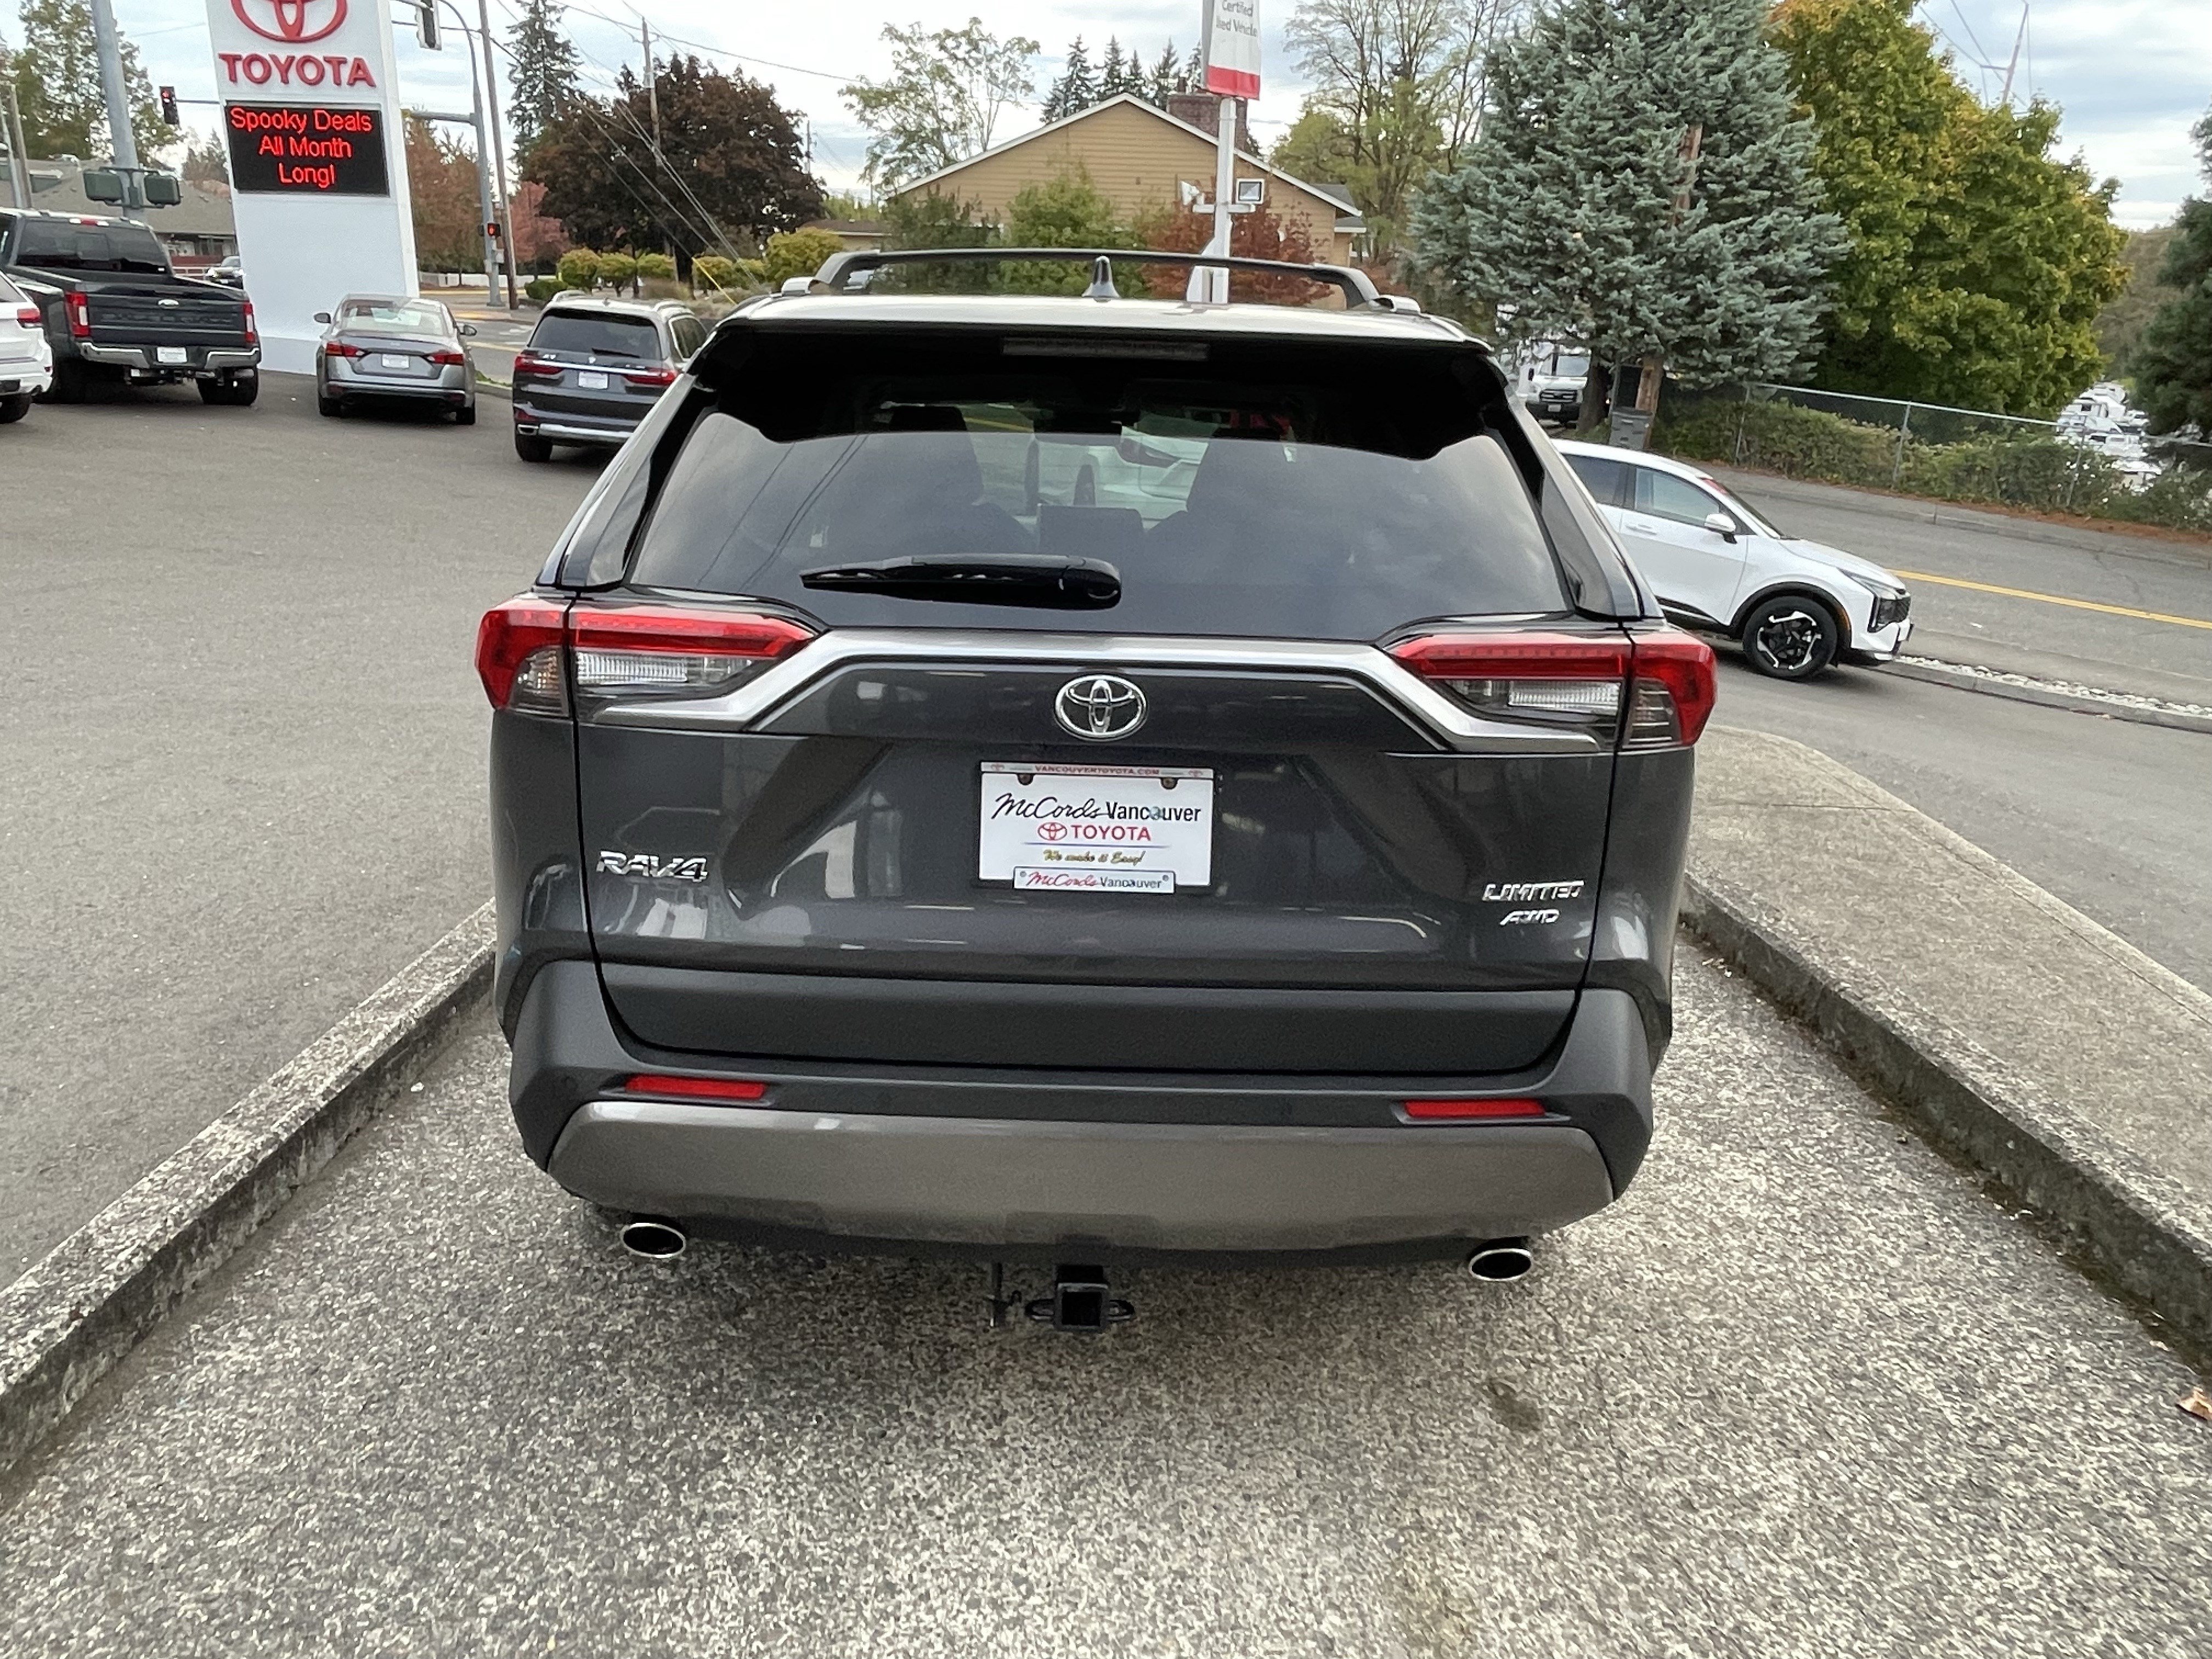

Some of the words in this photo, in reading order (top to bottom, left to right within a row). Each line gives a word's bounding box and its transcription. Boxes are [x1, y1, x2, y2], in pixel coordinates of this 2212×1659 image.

[218, 53, 376, 88] TOYOTA
[230, 107, 307, 134] Spooky
[313, 109, 373, 132] Deals
[258, 135, 284, 156] All
[289, 136, 353, 159] Month
[1035, 765, 1160, 775] VANCOUVERTOYOTA.COM
[1071, 824, 1151, 841] TOYOTA
[596, 850, 708, 882] RAV4
[1482, 880, 1585, 901] LIMITED
[1499, 909, 1560, 926] AWD
